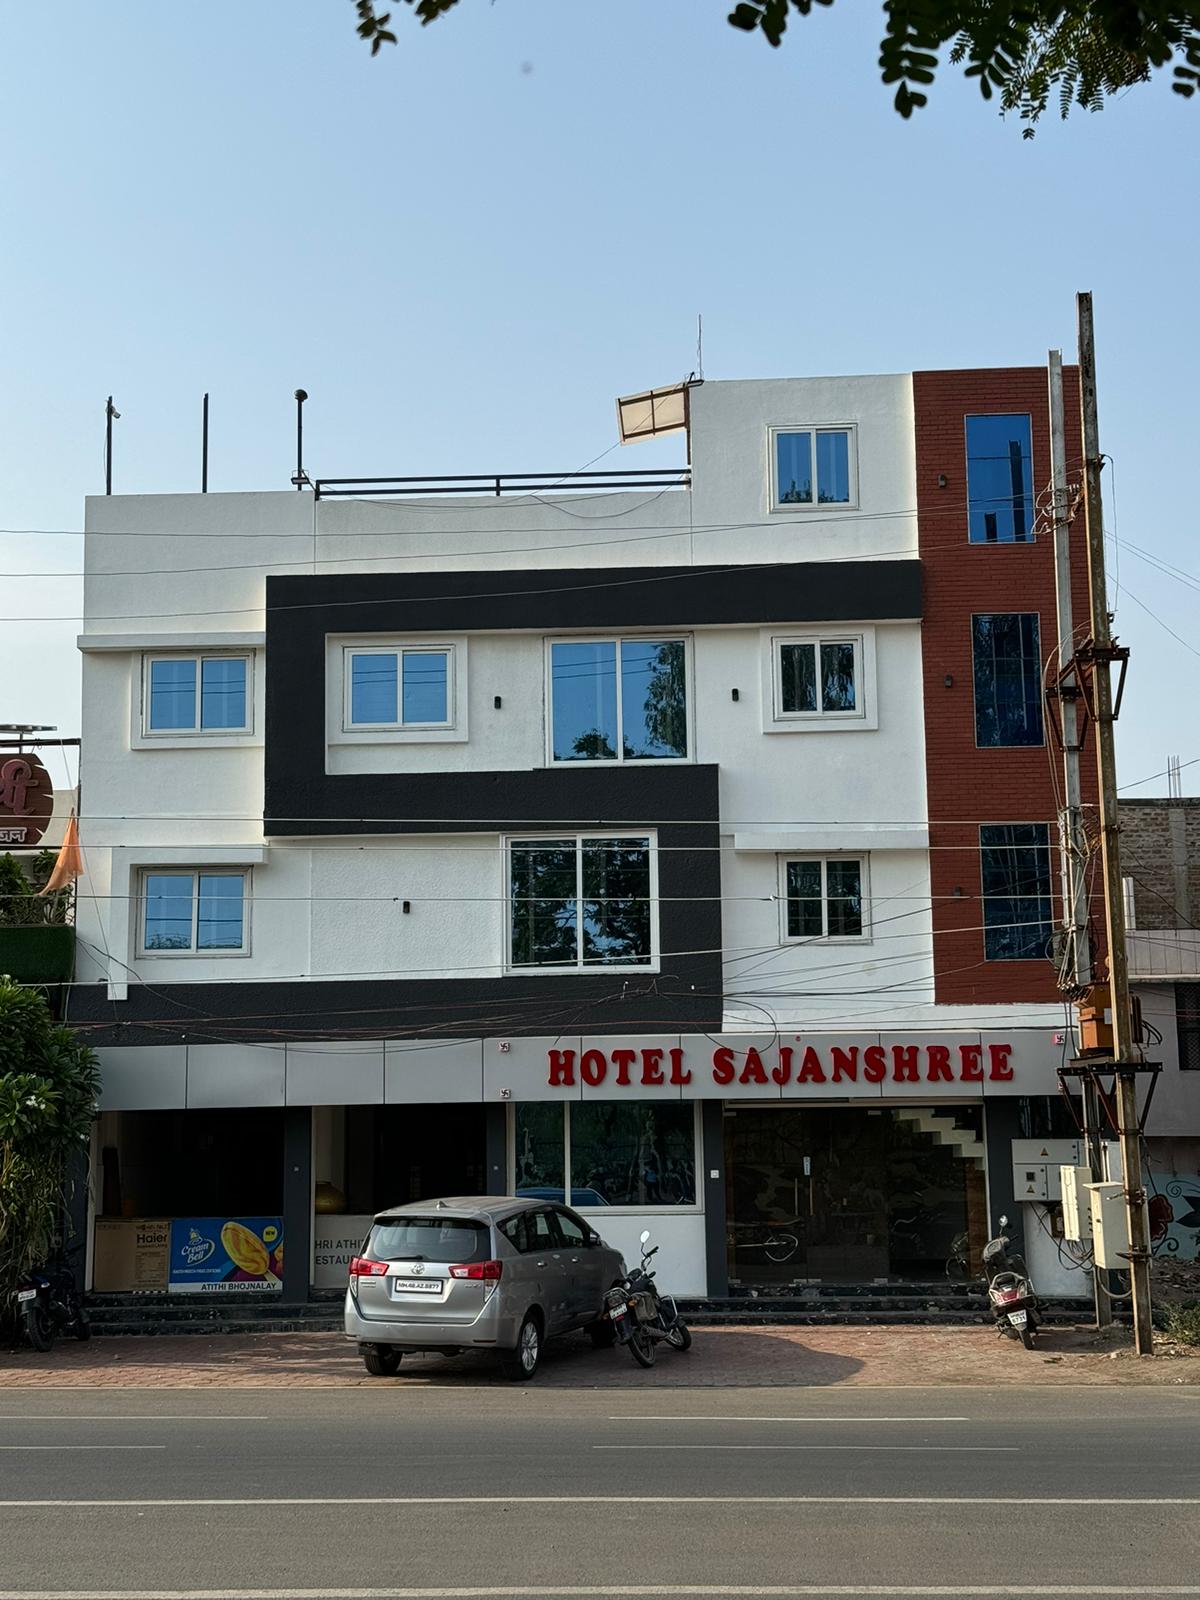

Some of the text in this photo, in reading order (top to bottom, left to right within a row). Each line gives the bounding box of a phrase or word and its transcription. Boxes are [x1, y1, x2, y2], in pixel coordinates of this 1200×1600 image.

[548, 1044, 1014, 1085] HOTEL SAJANSHREE
[137, 1232, 168, 1243] Haier
[181, 1243, 209, 1256] Cream
[187, 1251, 205, 1264] Bell
[201, 1282, 277, 1291] ATITHI BHOJNALAY
